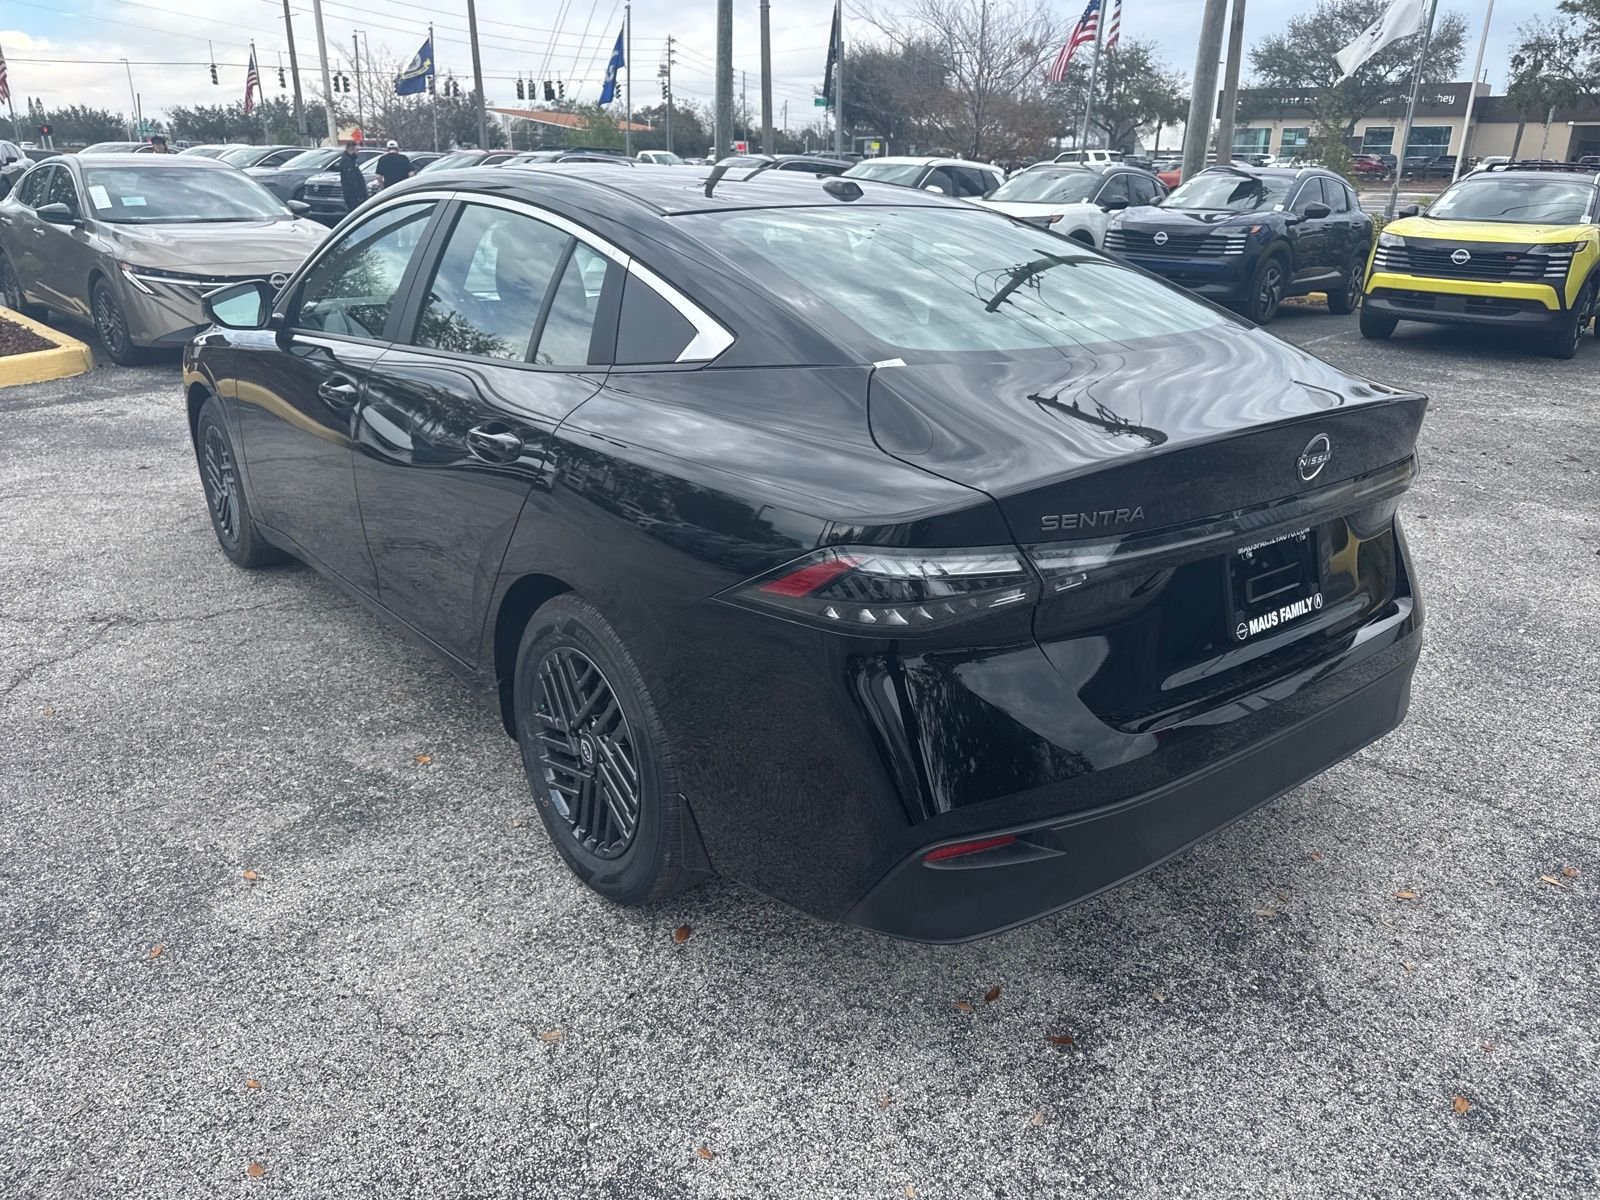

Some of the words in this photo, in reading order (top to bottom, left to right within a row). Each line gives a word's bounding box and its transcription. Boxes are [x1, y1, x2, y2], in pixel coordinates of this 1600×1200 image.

[1041, 506, 1145, 531] SENTRA
[1249, 611, 1279, 635] MAUS
[1280, 597, 1313, 623] FAMILY
